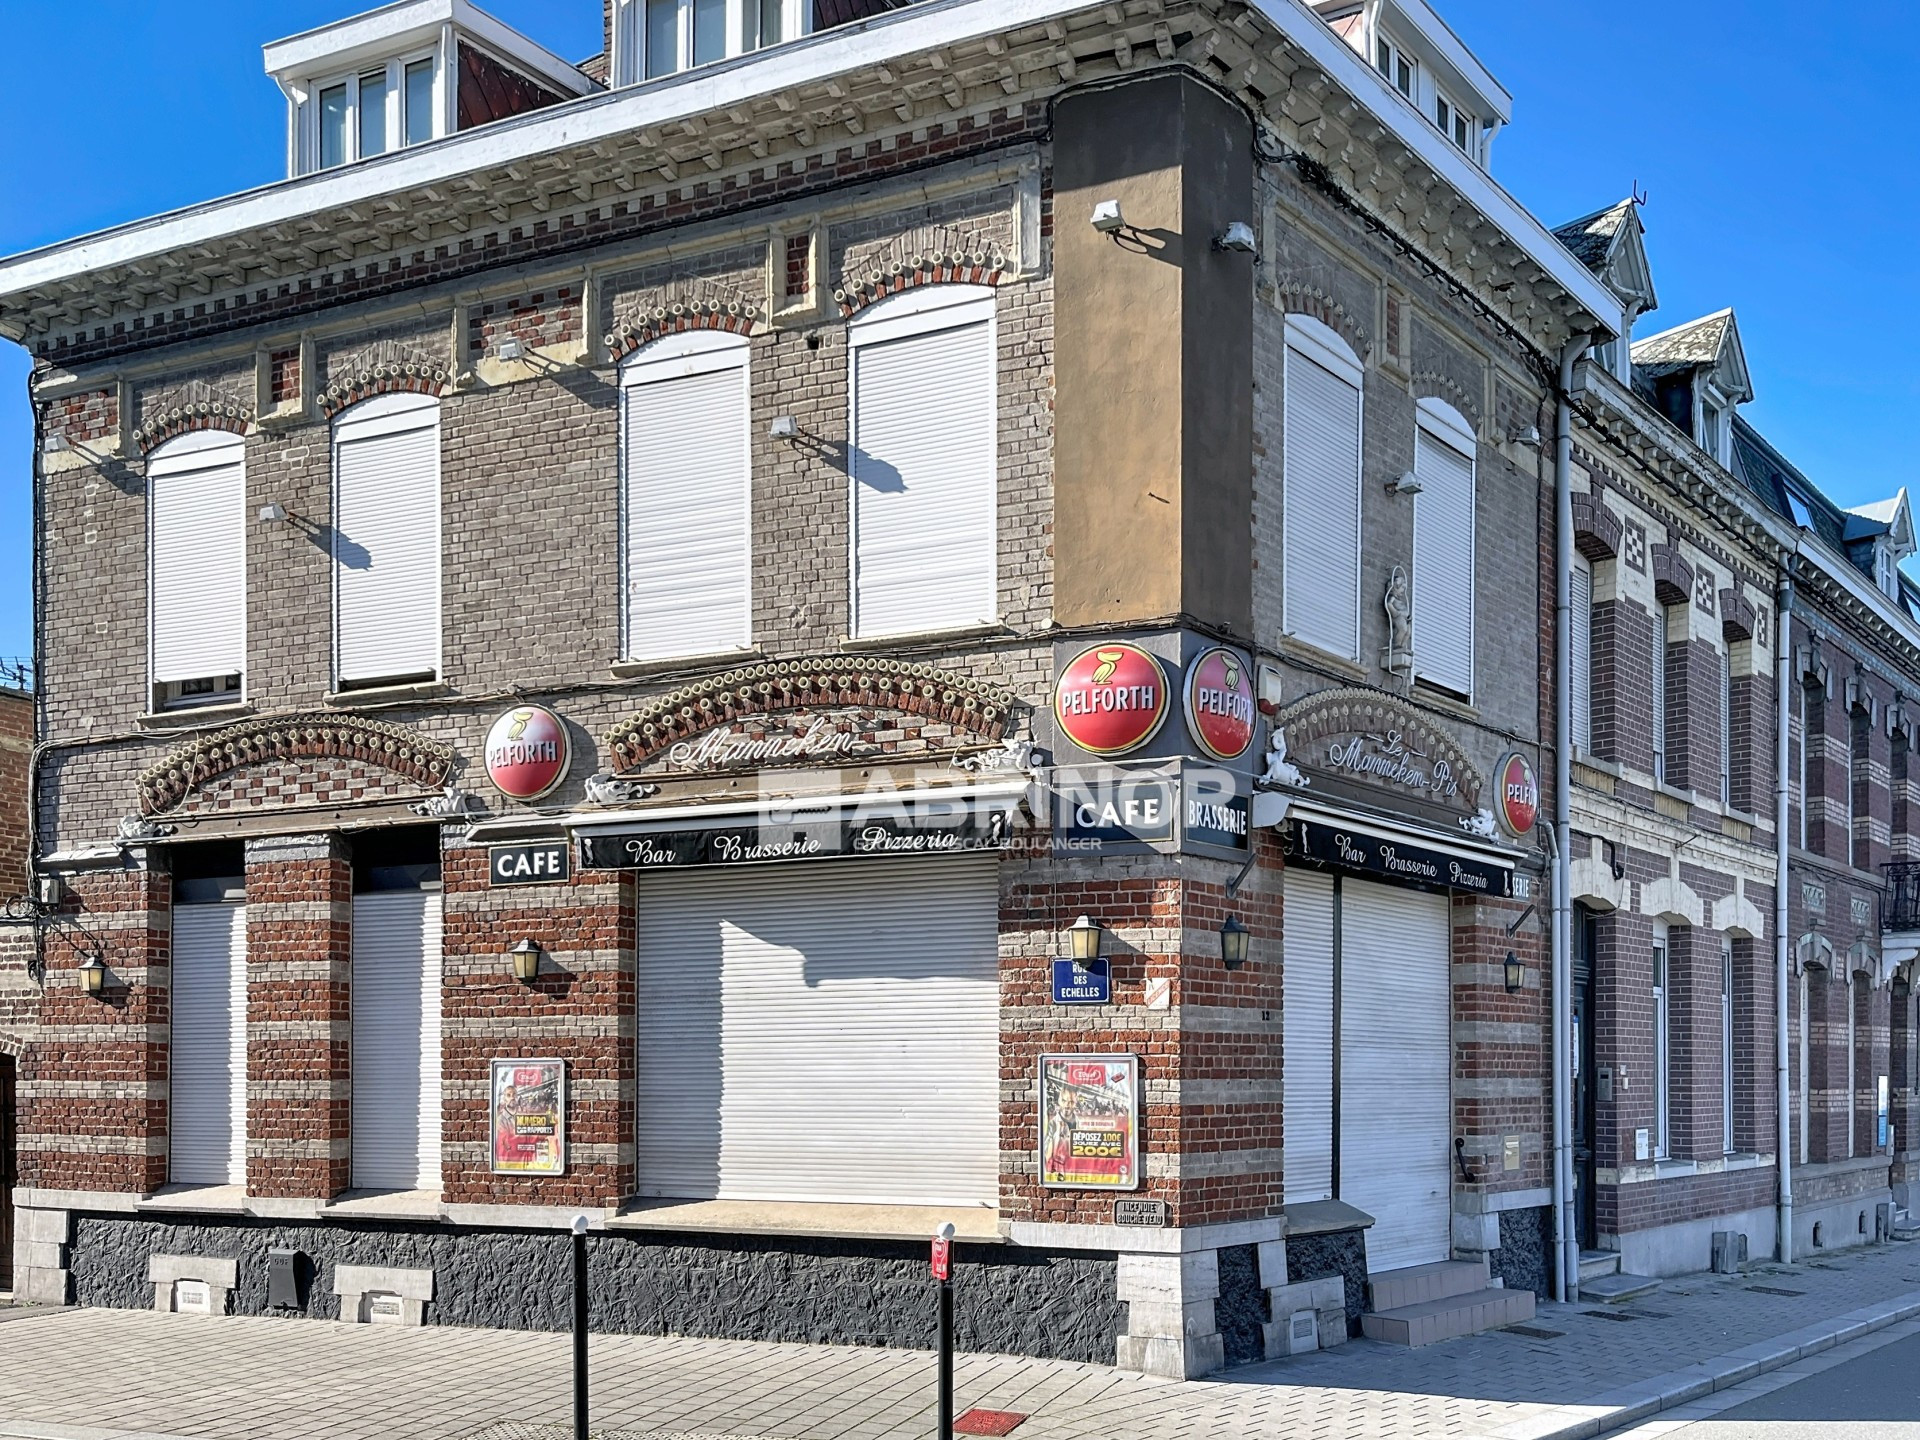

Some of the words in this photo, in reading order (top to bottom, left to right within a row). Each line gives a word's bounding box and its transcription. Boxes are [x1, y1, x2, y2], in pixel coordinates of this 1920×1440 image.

[1062, 685, 1155, 716] PELFORTH
[1199, 687, 1253, 725] PELFORT
[489, 740, 558, 769] PELFORTH
[1382, 729, 1402, 756] Le
[1076, 798, 1160, 828] CAFE
[1188, 799, 1247, 836] BRASSERIE
[625, 839, 677, 864] Bar
[713, 835, 822, 861] Brasserie
[862, 826, 959, 851] Pizzeria
[497, 850, 561, 878] CAFE
[1335, 833, 1367, 863] Bar
[1379, 845, 1438, 877] Brasserie
[1449, 861, 1489, 890] Pizzeria
[1061, 987, 1100, 998] ECHELLES
[1073, 975, 1088, 985] DES
[1261, 1010, 1270, 1021] 12
[1072, 1145, 1122, 1157] 200€
[1102, 1133, 1122, 1142] 100€
[1123, 1201, 1158, 1213] INCENDIE
